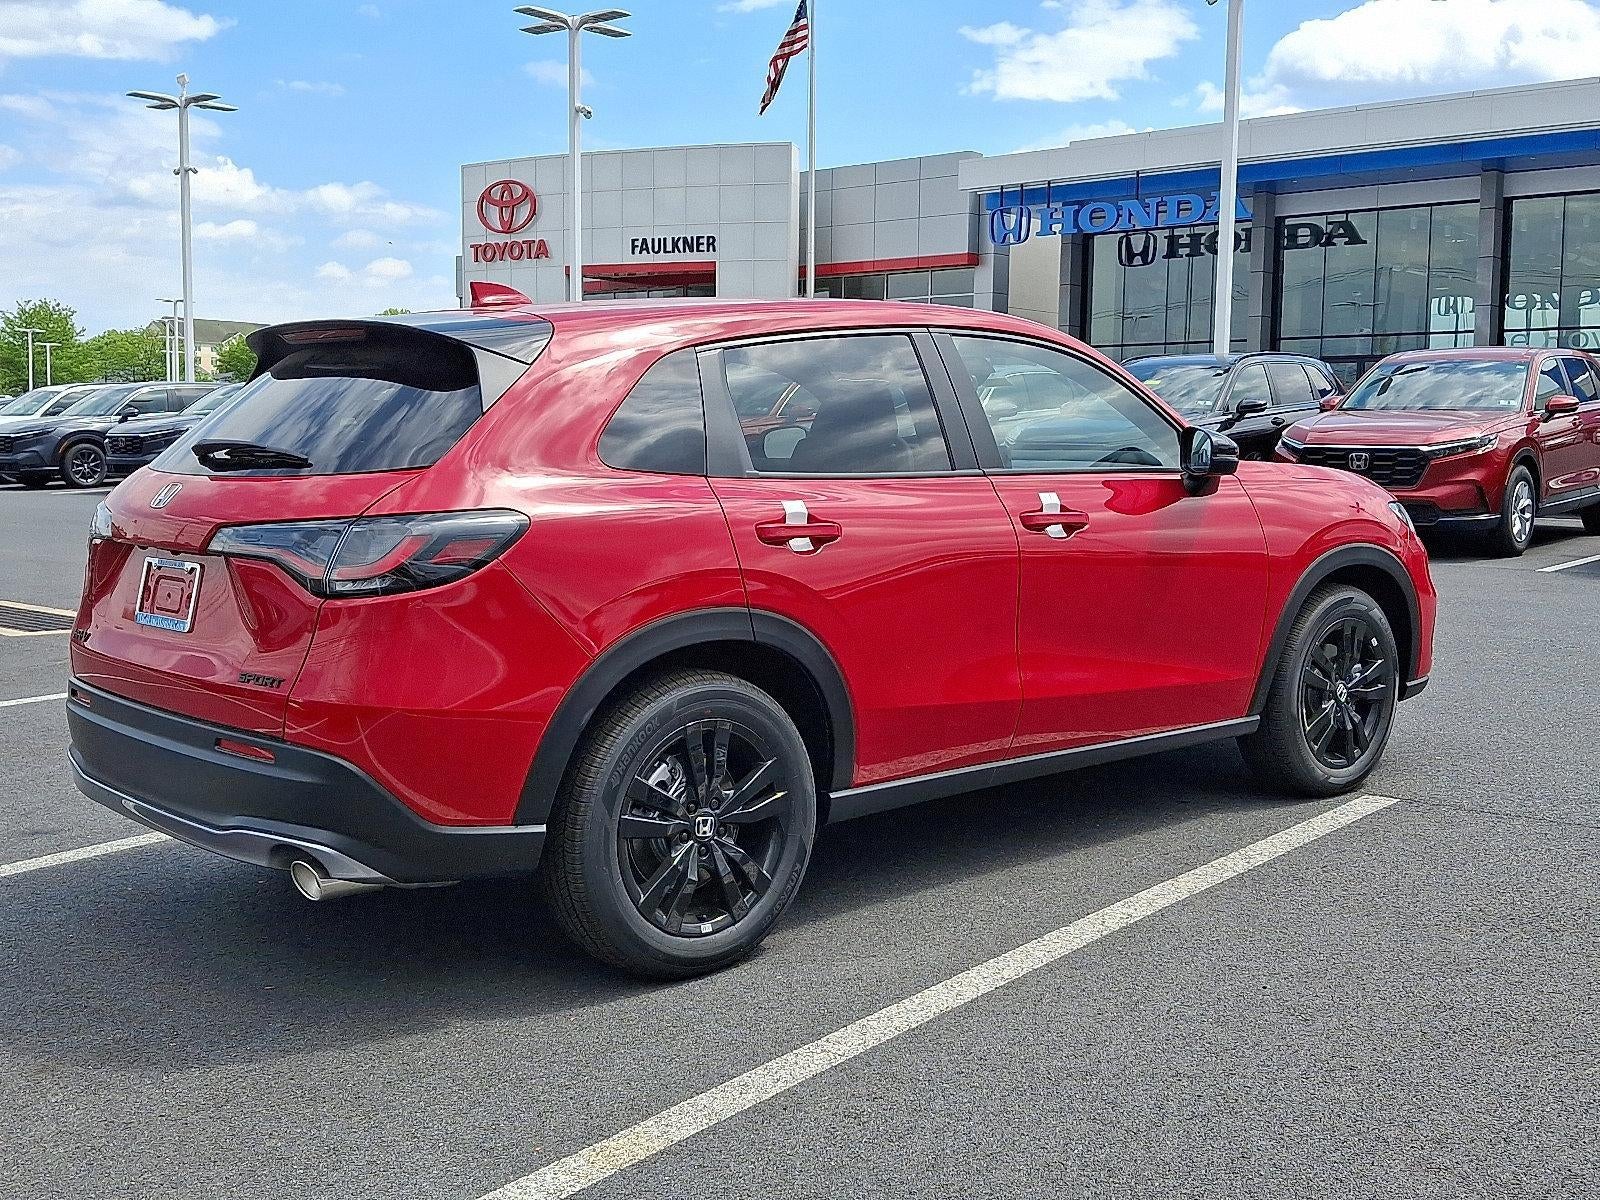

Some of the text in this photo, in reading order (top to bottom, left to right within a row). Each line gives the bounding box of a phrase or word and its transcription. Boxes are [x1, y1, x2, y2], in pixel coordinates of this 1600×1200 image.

[1036, 190, 1254, 236] HONDA
[470, 239, 550, 263] TOYOTA
[631, 235, 716, 255] FAULKNER
[1162, 219, 1367, 260] HODA
[238, 672, 286, 688] SPORT
